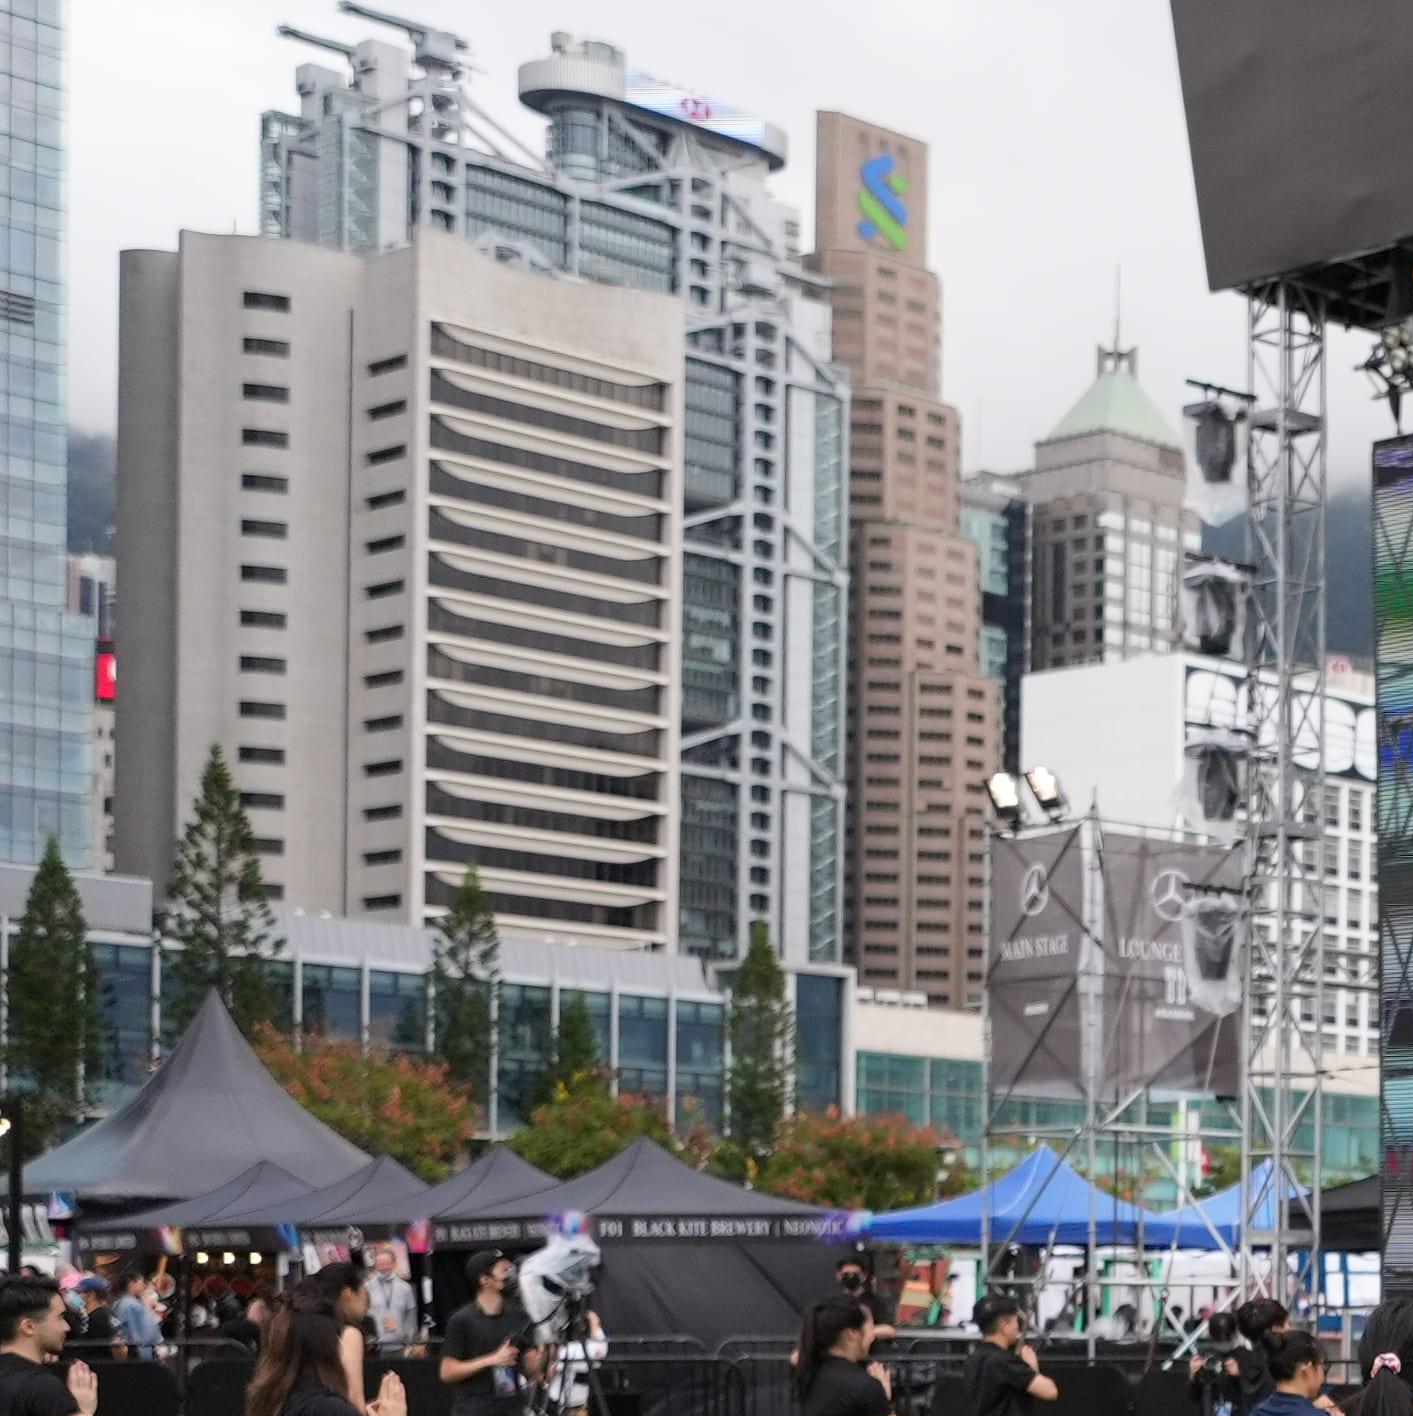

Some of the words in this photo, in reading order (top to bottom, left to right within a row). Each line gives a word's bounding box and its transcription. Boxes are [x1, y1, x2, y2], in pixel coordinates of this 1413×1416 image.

[1000, 938, 1033, 961] MAIN
[1035, 934, 1069, 957] STAGE
[633, 1218, 676, 1237] BLACK
[678, 1219, 708, 1237] KITE
[711, 1218, 771, 1237] BREWERY
